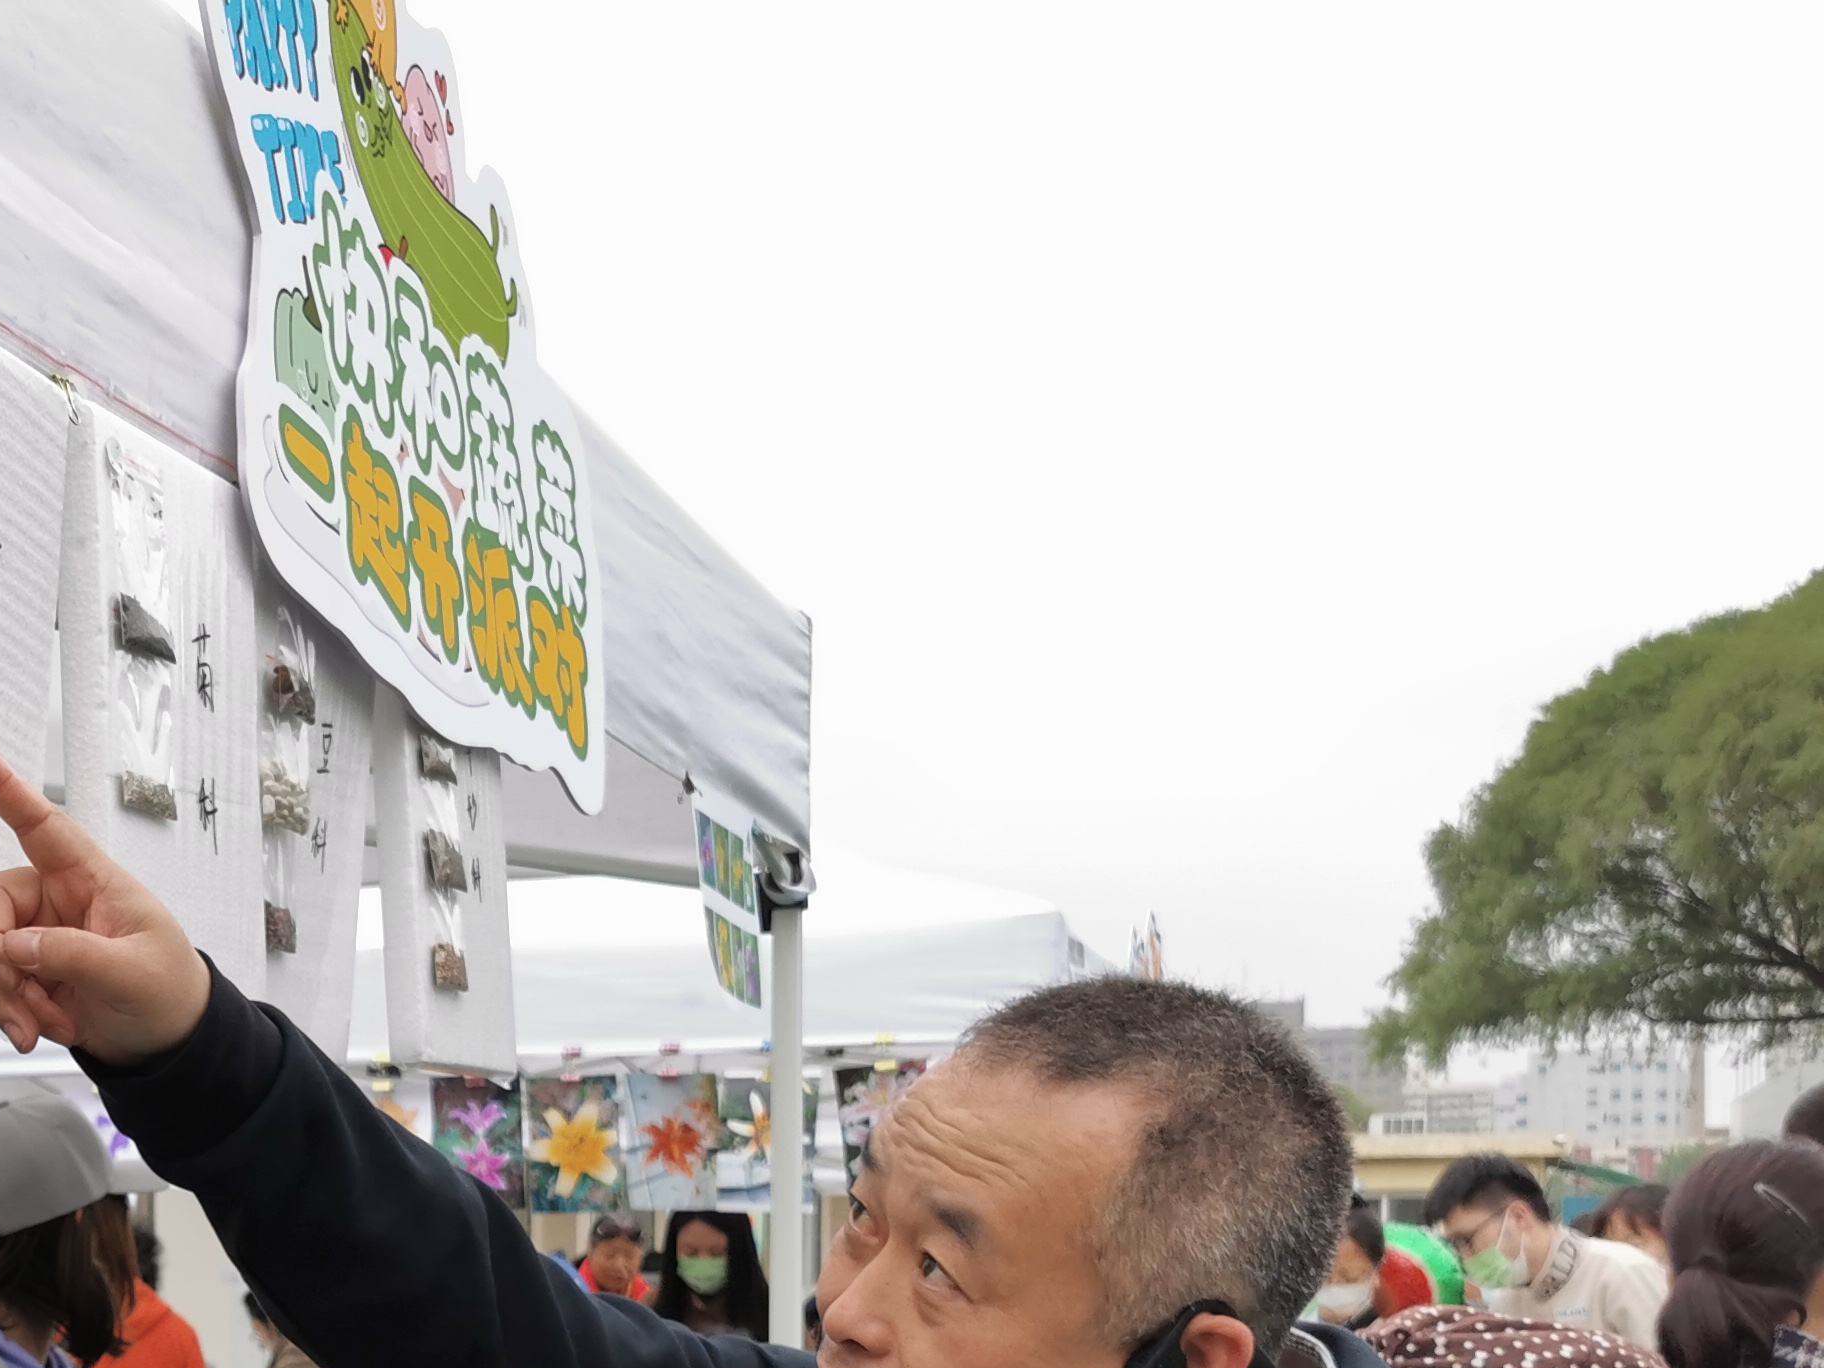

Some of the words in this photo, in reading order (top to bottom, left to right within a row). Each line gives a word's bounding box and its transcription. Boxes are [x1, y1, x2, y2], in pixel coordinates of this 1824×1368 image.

[278, 403, 588, 762] 一起开派对
[312, 188, 588, 632] 快和蔬菜
[311, 721, 333, 874] 豆科
